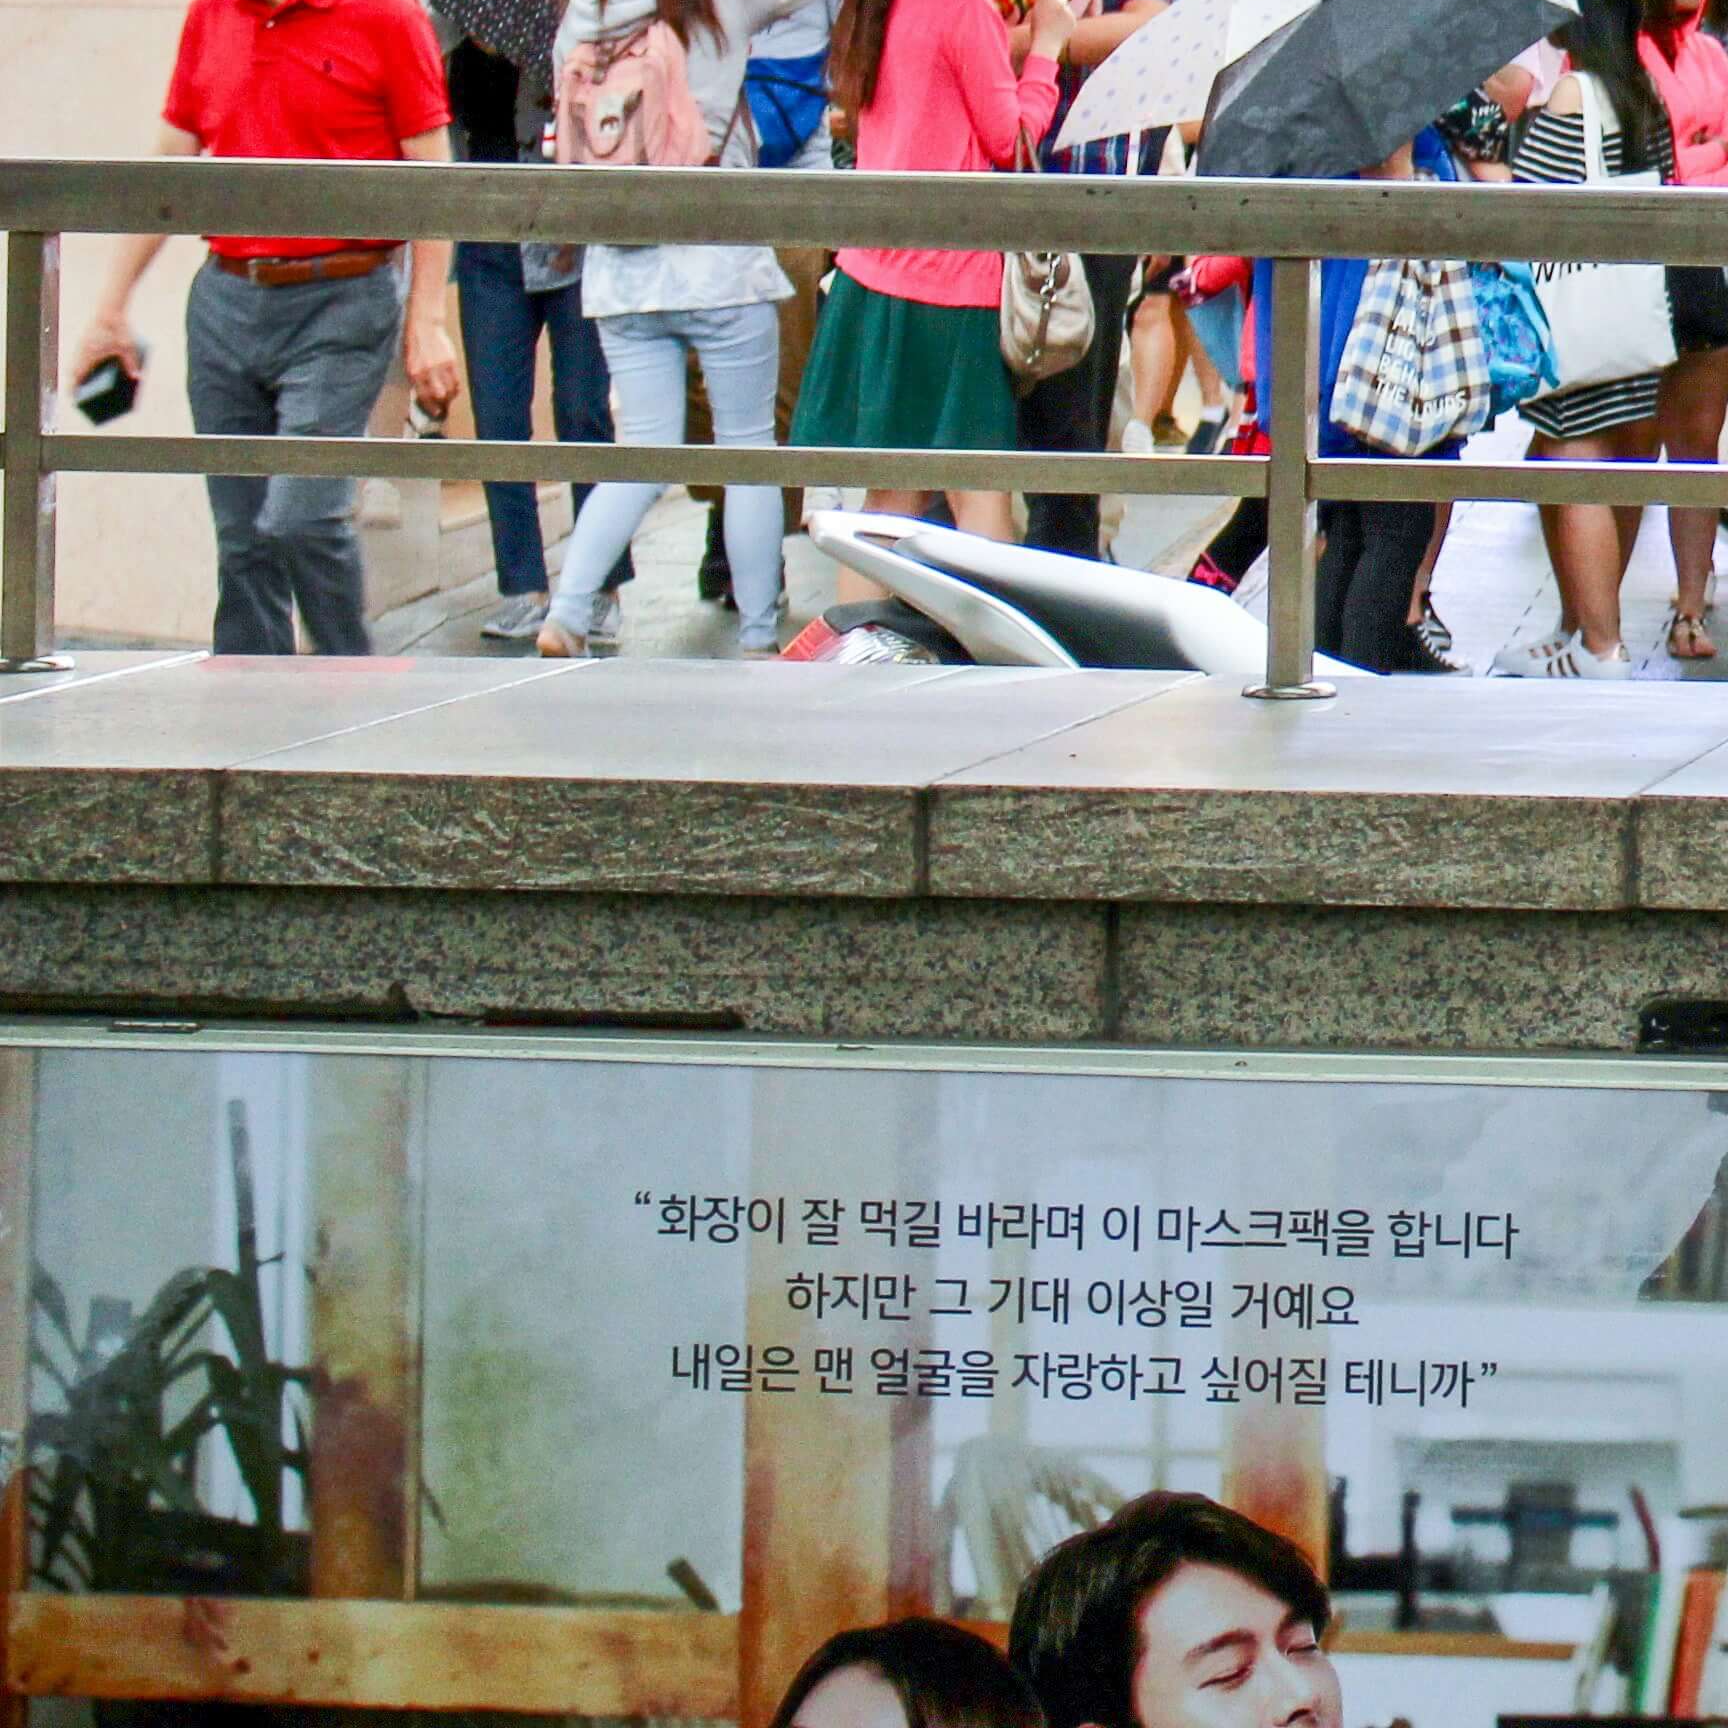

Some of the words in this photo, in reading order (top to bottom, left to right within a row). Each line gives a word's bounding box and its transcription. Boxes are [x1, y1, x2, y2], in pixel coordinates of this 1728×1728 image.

[1412, 388, 1467, 422] LOUDS
[634, 1190, 785, 1245] “화장이
[801, 1198, 846, 1246] 잘
[860, 1199, 941, 1249] 먹길
[957, 1201, 1085, 1252] 바라며
[1102, 1204, 1141, 1253] 이
[1157, 1205, 1375, 1258] 마스크팩을
[1387, 1209, 1521, 1261] 합니다
[785, 1271, 918, 1322] 하지만
[928, 1279, 973, 1315] 그
[987, 1276, 1070, 1325] 기대
[1087, 1279, 1213, 1329] 이상일
[1230, 1281, 1360, 1331] 거예요
[672, 1343, 800, 1393] 내일은
[814, 1347, 853, 1394] 맨
[870, 1347, 1000, 1398] 얼굴을
[1010, 1351, 1187, 1401] 자랑하고
[1200, 1355, 1327, 1406] 싶어질
[1344, 1358, 1498, 1409] 테니까”
